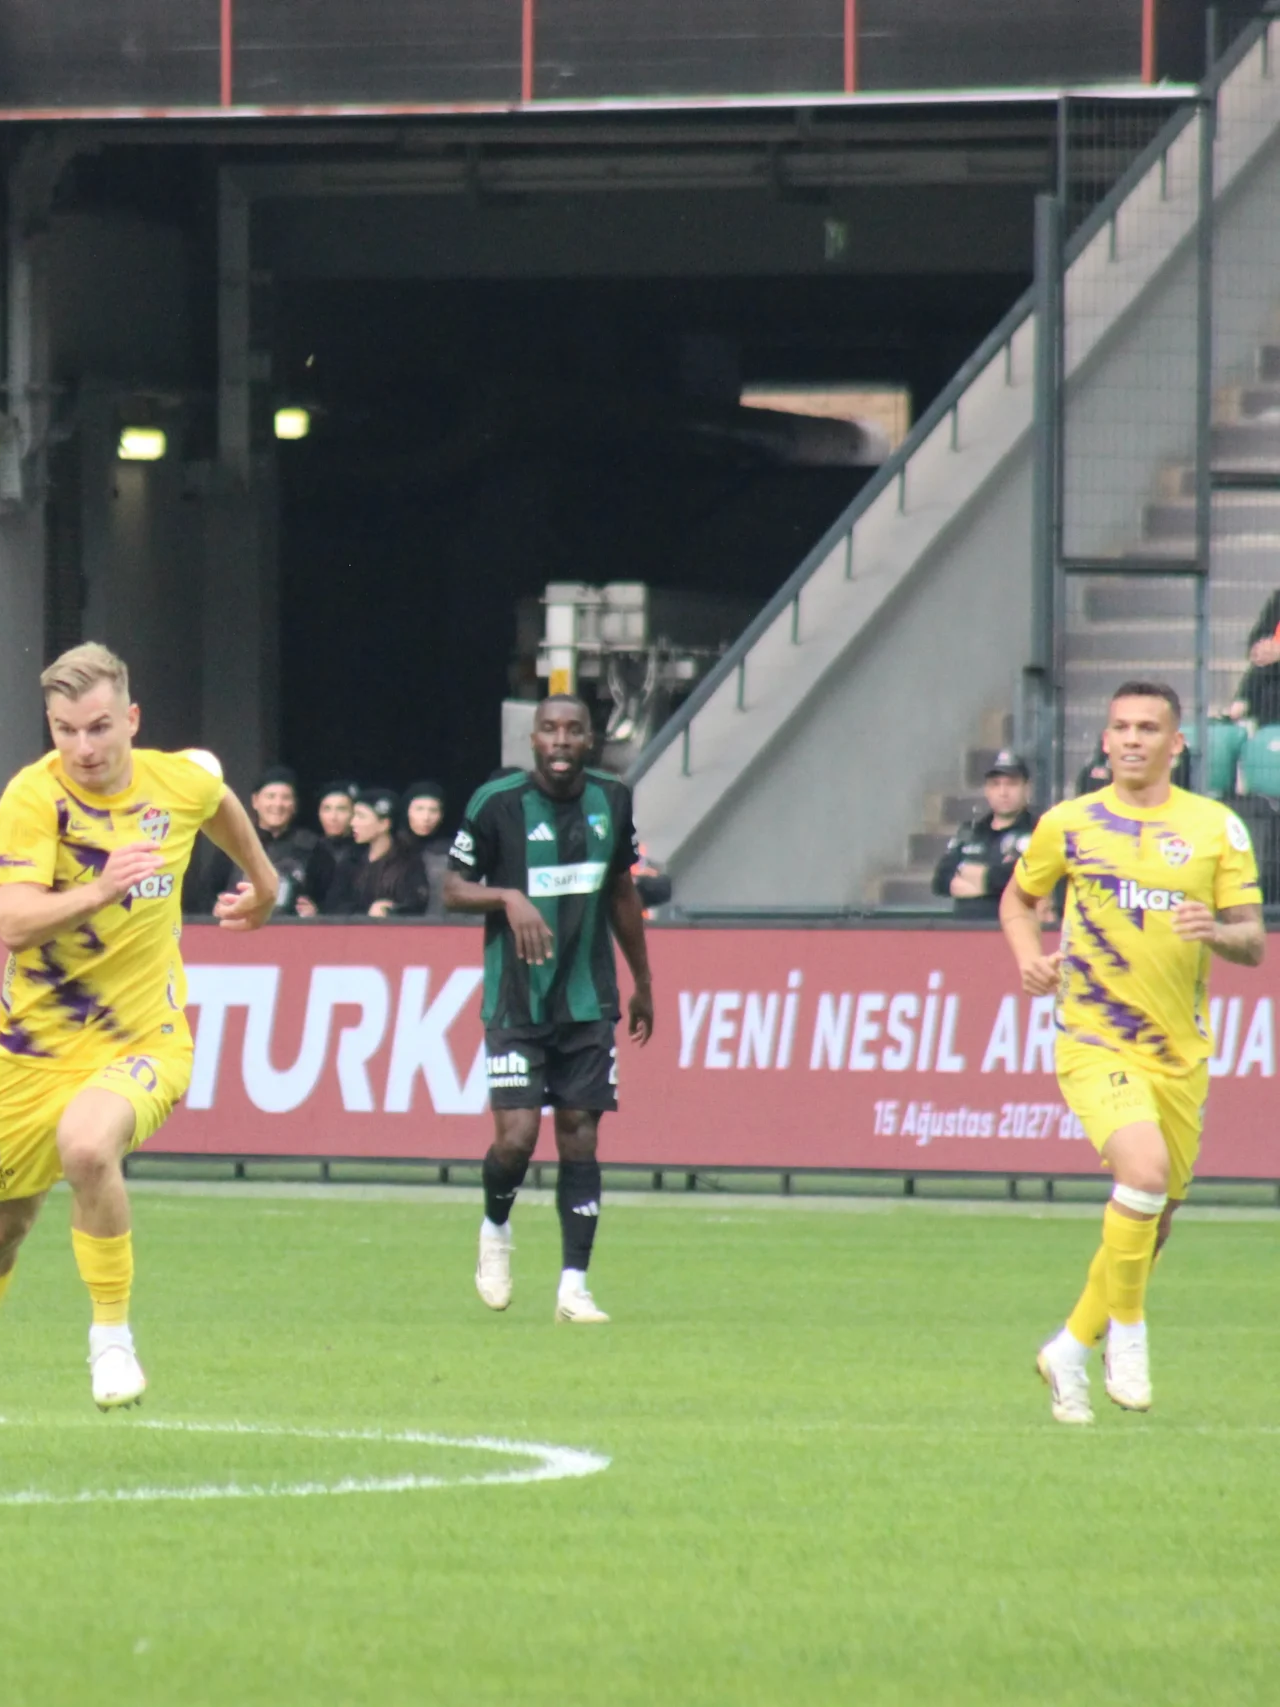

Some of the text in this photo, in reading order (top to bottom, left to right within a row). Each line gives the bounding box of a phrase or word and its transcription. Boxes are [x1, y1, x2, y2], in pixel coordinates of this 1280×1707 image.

[129, 874, 174, 898] as
[1118, 880, 1186, 911] ikas
[678, 969, 803, 1070] YENİ
[809, 970, 966, 1073] NESİL
[980, 993, 1058, 1074] AR
[874, 1101, 1088, 1146] 15 Ağustos 2027'de
